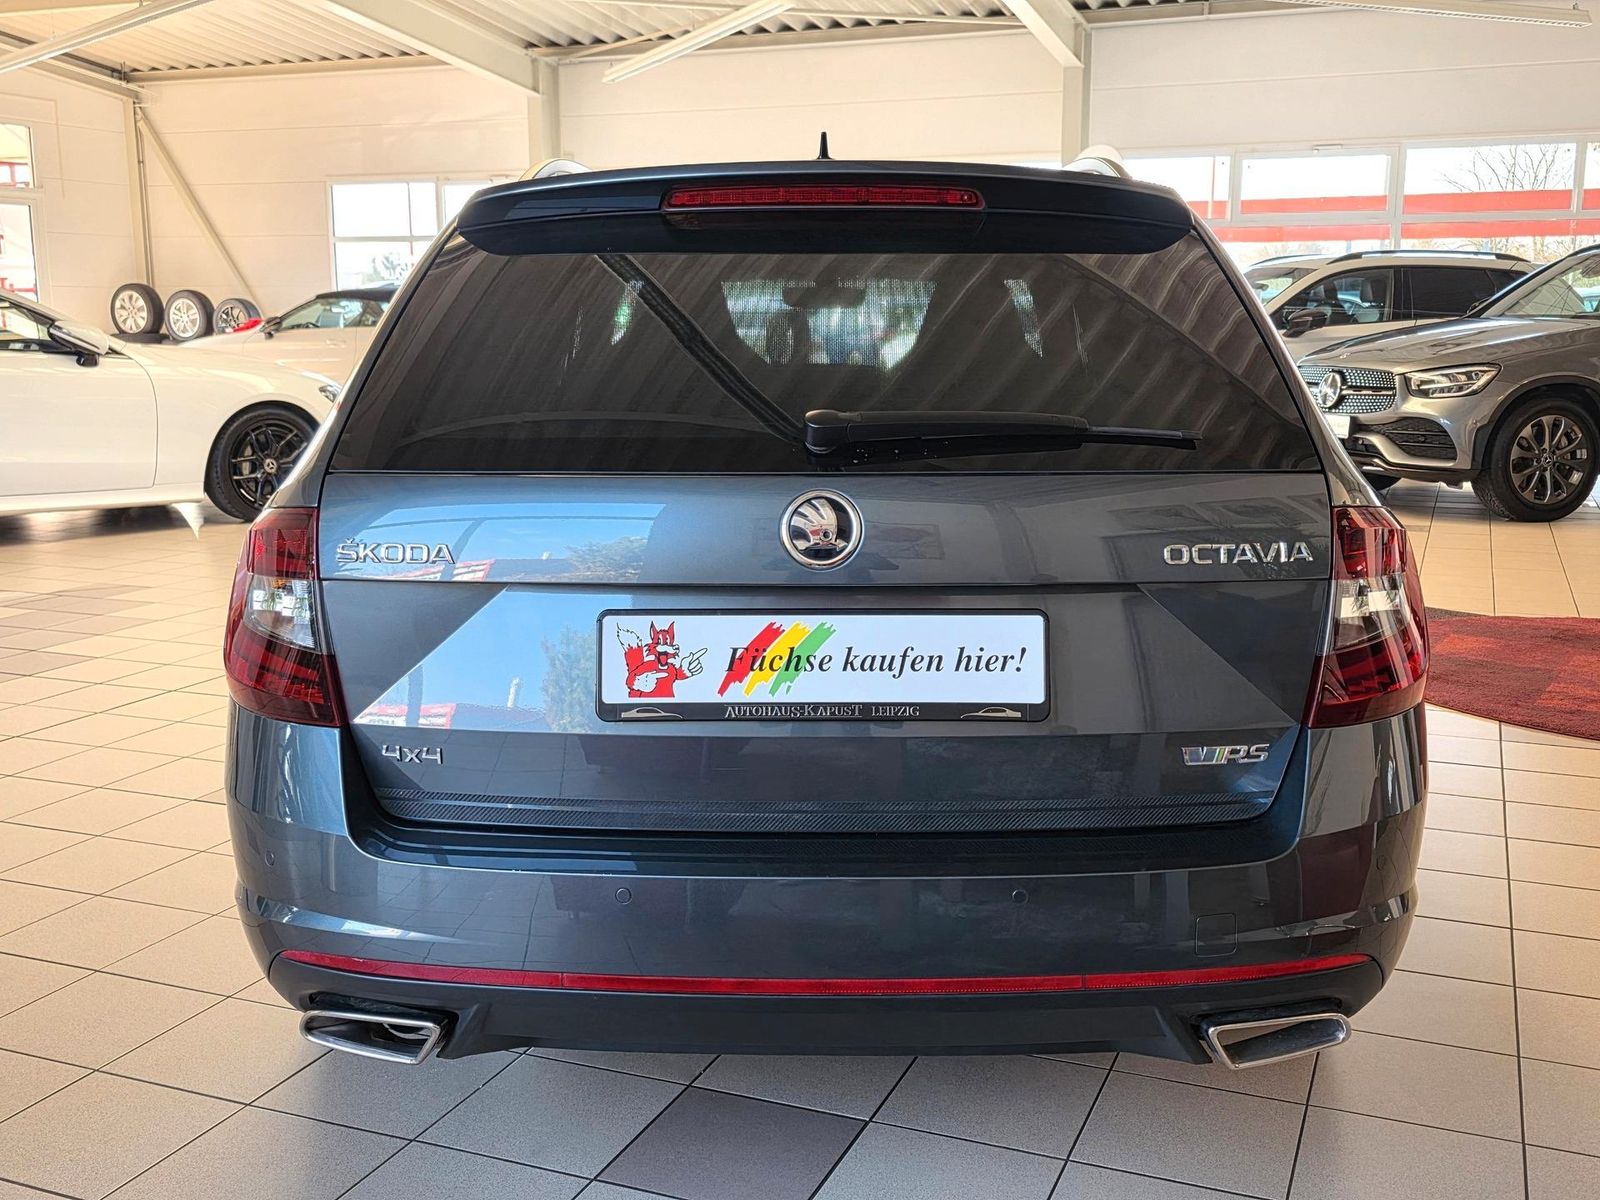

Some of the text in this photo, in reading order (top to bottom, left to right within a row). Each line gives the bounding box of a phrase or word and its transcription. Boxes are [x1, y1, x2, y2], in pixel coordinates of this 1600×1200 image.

[336, 537, 455, 564] ŠKODA
[1163, 541, 1314, 565] OCTAVIA
[725, 646, 1027, 680] Füchse kaufen hier!
[871, 705, 920, 718] LEIPZIG
[381, 744, 444, 765] 4x4
